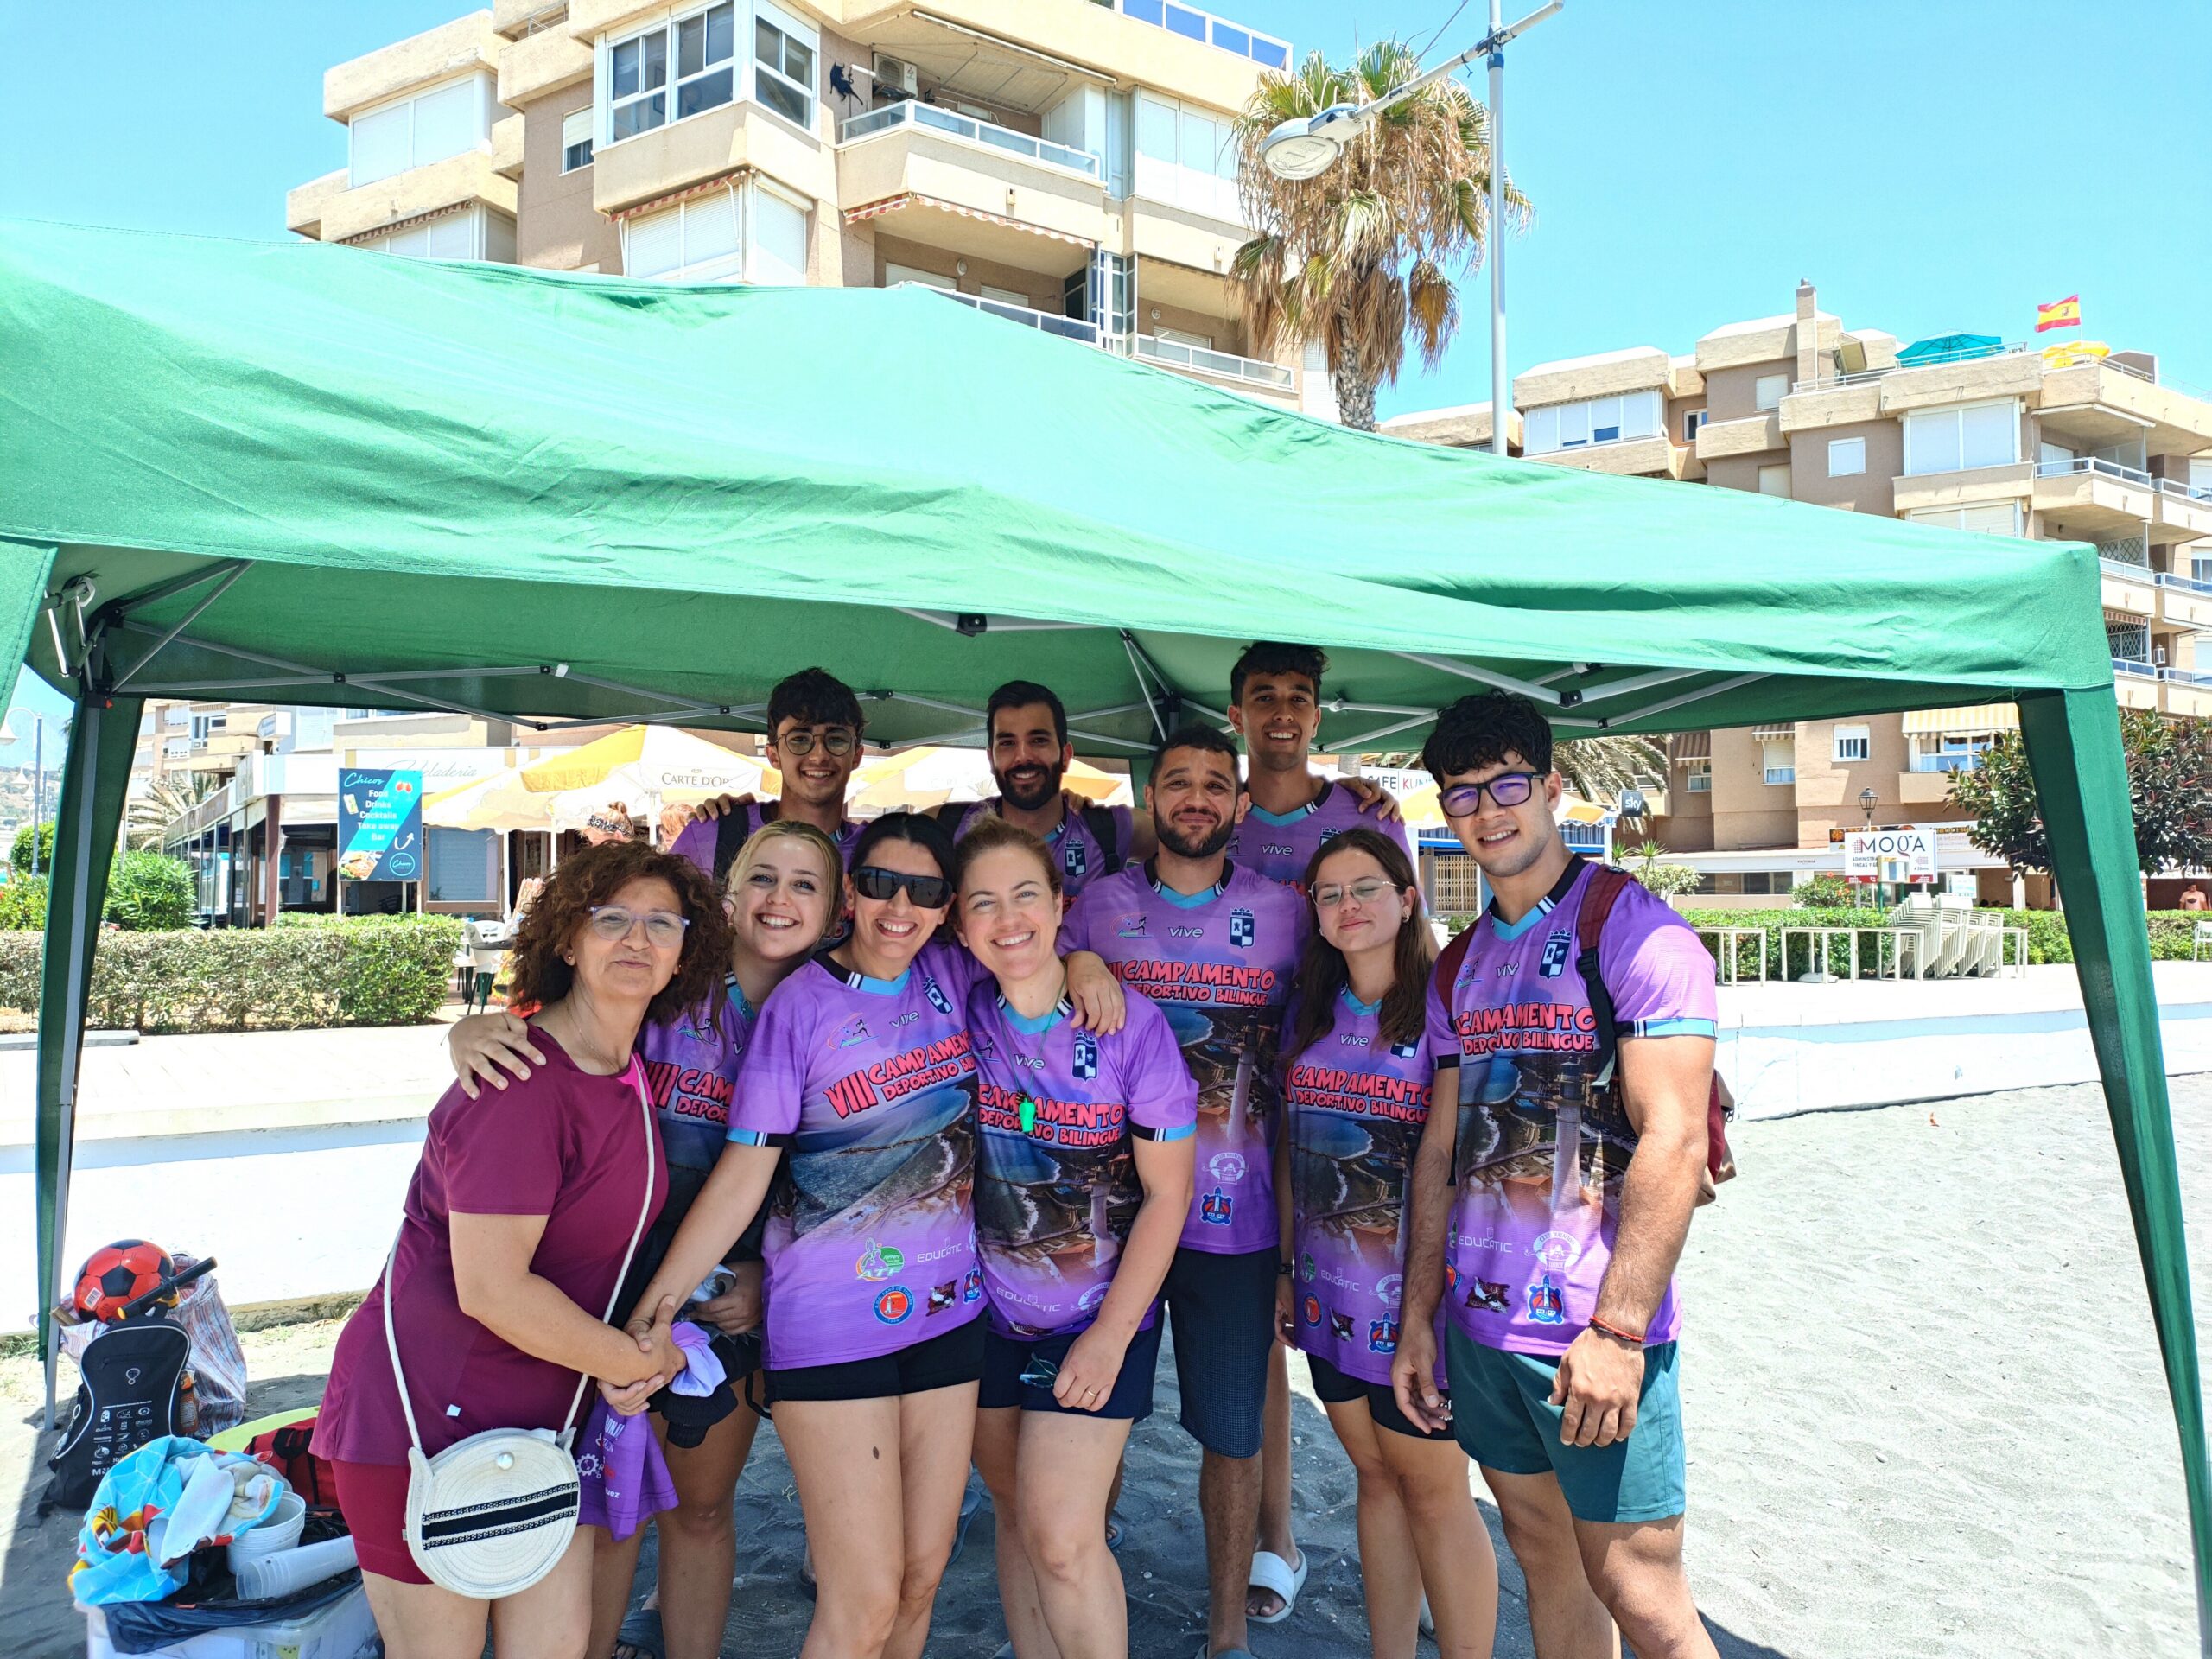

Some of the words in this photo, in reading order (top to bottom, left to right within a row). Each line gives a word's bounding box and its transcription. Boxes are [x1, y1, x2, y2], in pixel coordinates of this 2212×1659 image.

[661, 772, 698, 785] CARTE
[368, 789, 389, 798] Food
[1624, 796, 1642, 811] sky
[1262, 843, 1293, 856] vive
[1168, 925, 1204, 938] vive
[1123, 959, 1276, 992] CAMPAMENTO
[1215, 987, 1268, 1007] BILINGUE
[1339, 1033, 1369, 1047] vive
[1521, 1030, 1595, 1052] BILINGUE
[881, 1062, 959, 1102] DEPORTIVO
[823, 1069, 879, 1120] VIII
[1294, 1089, 1367, 1113] DEPORTIVO
[1370, 1099, 1429, 1123] BILINGU
[1058, 1127, 1121, 1148] BILINGUE
[917, 1243, 962, 1262] EDUCATIC
[1459, 1236, 1513, 1253] EDUCATIC
